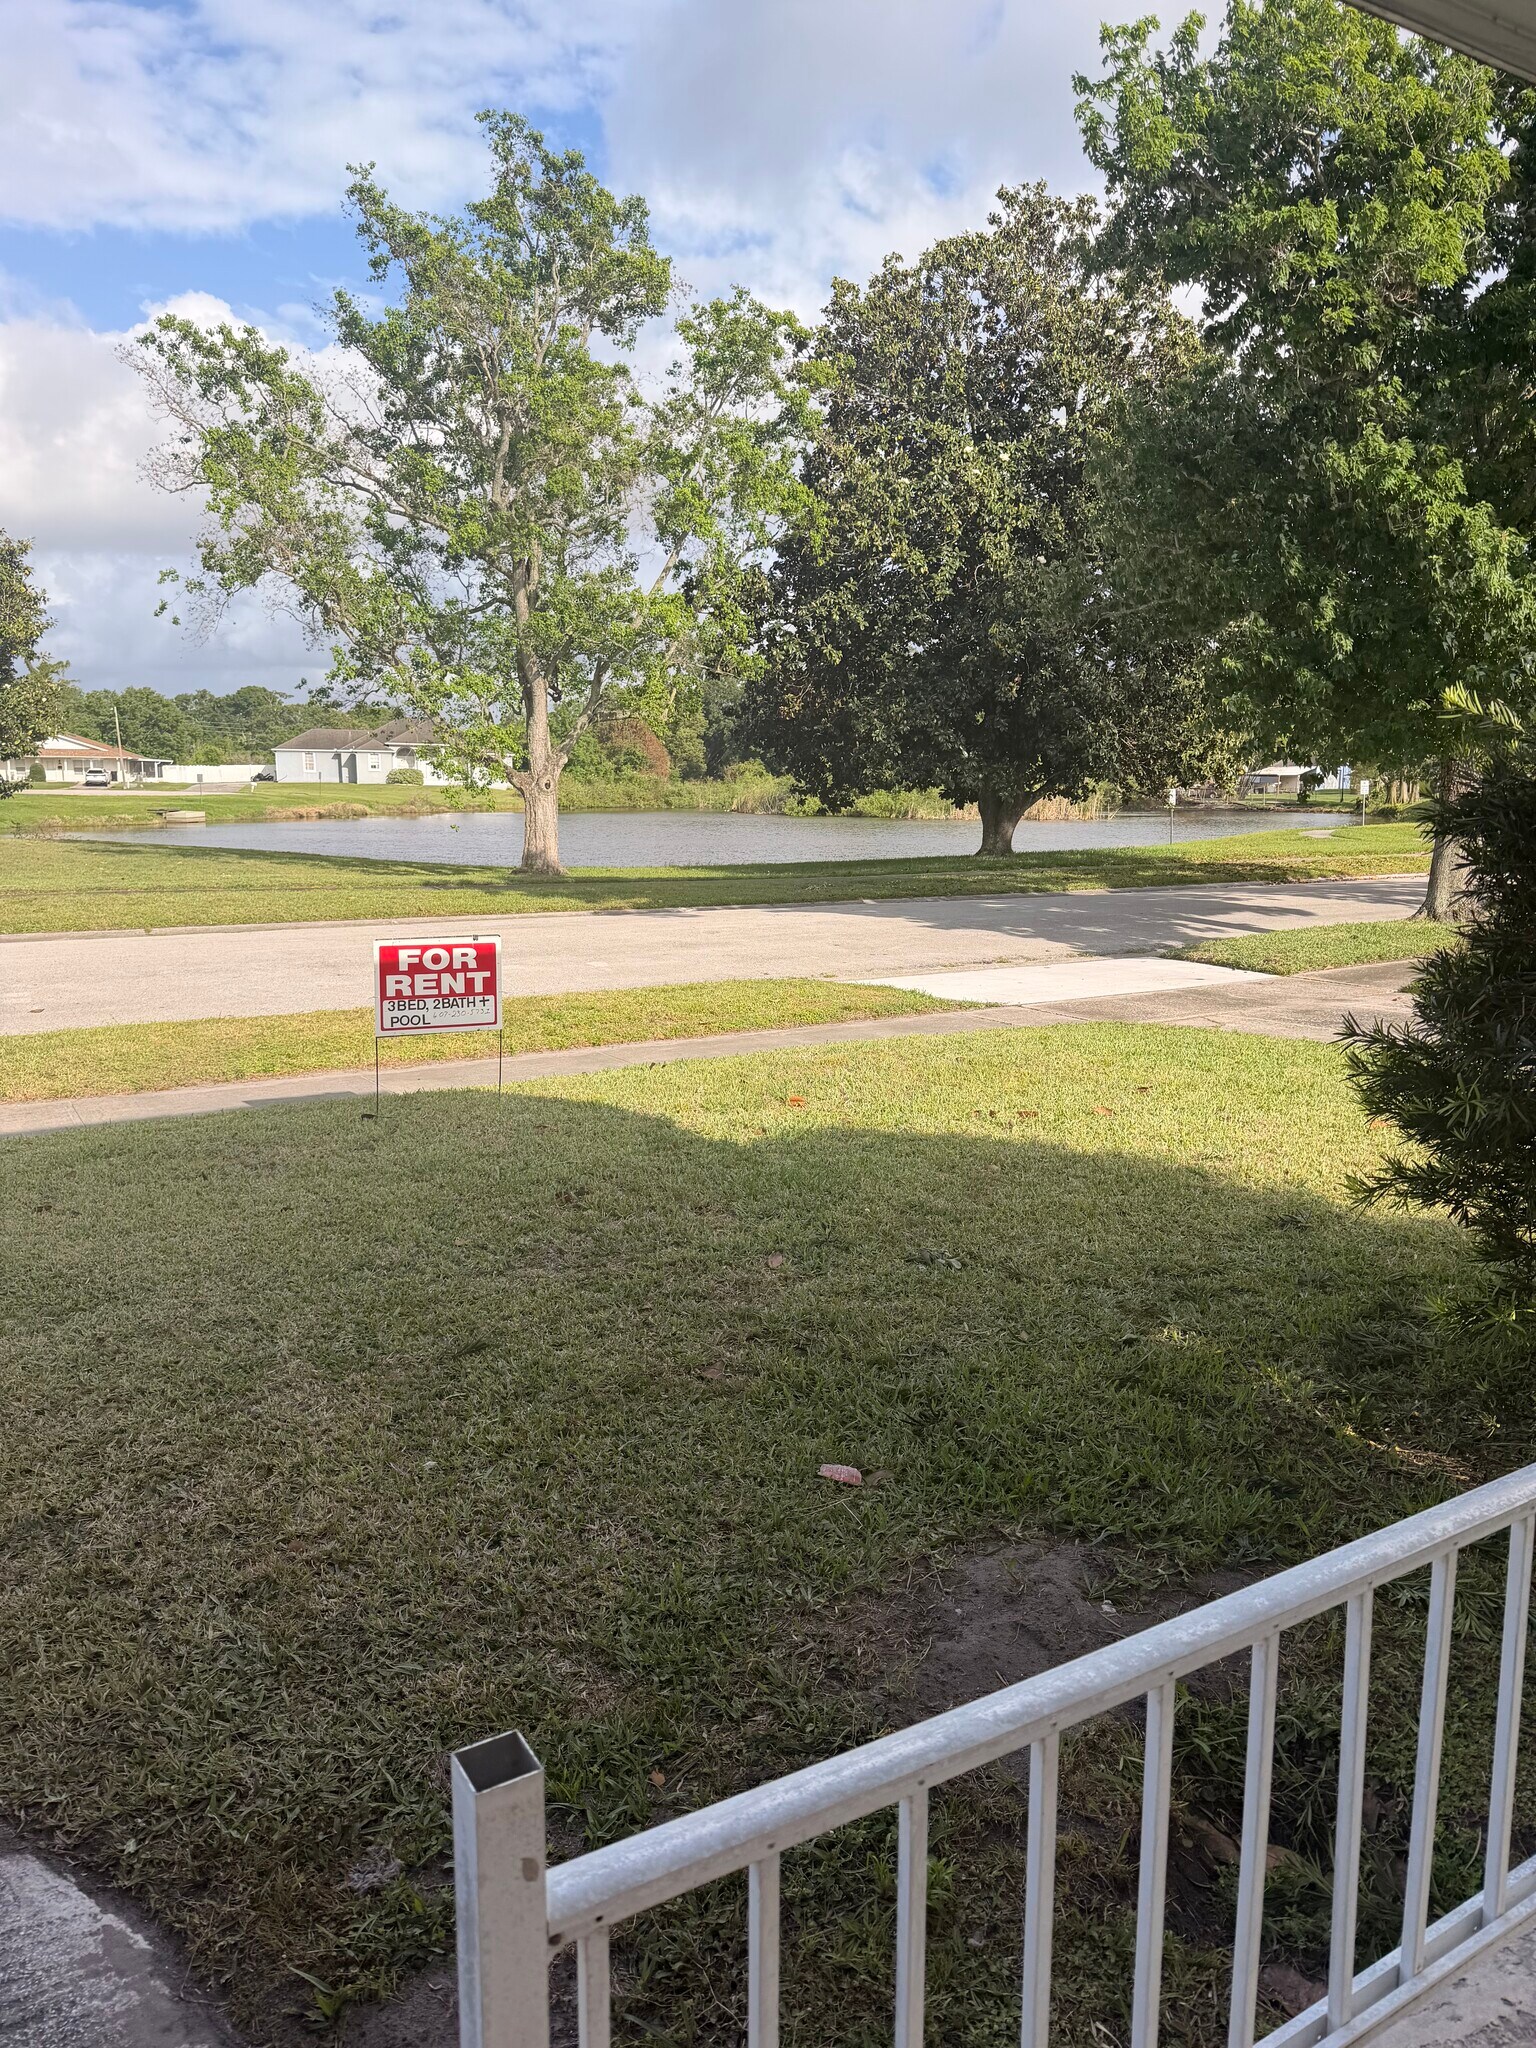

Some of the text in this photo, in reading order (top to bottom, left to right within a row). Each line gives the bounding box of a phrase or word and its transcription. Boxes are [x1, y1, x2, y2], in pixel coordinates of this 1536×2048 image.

[398, 948, 477, 971] FOR
[385, 971, 491, 997] RENT
[390, 1014, 431, 1027] POOL
